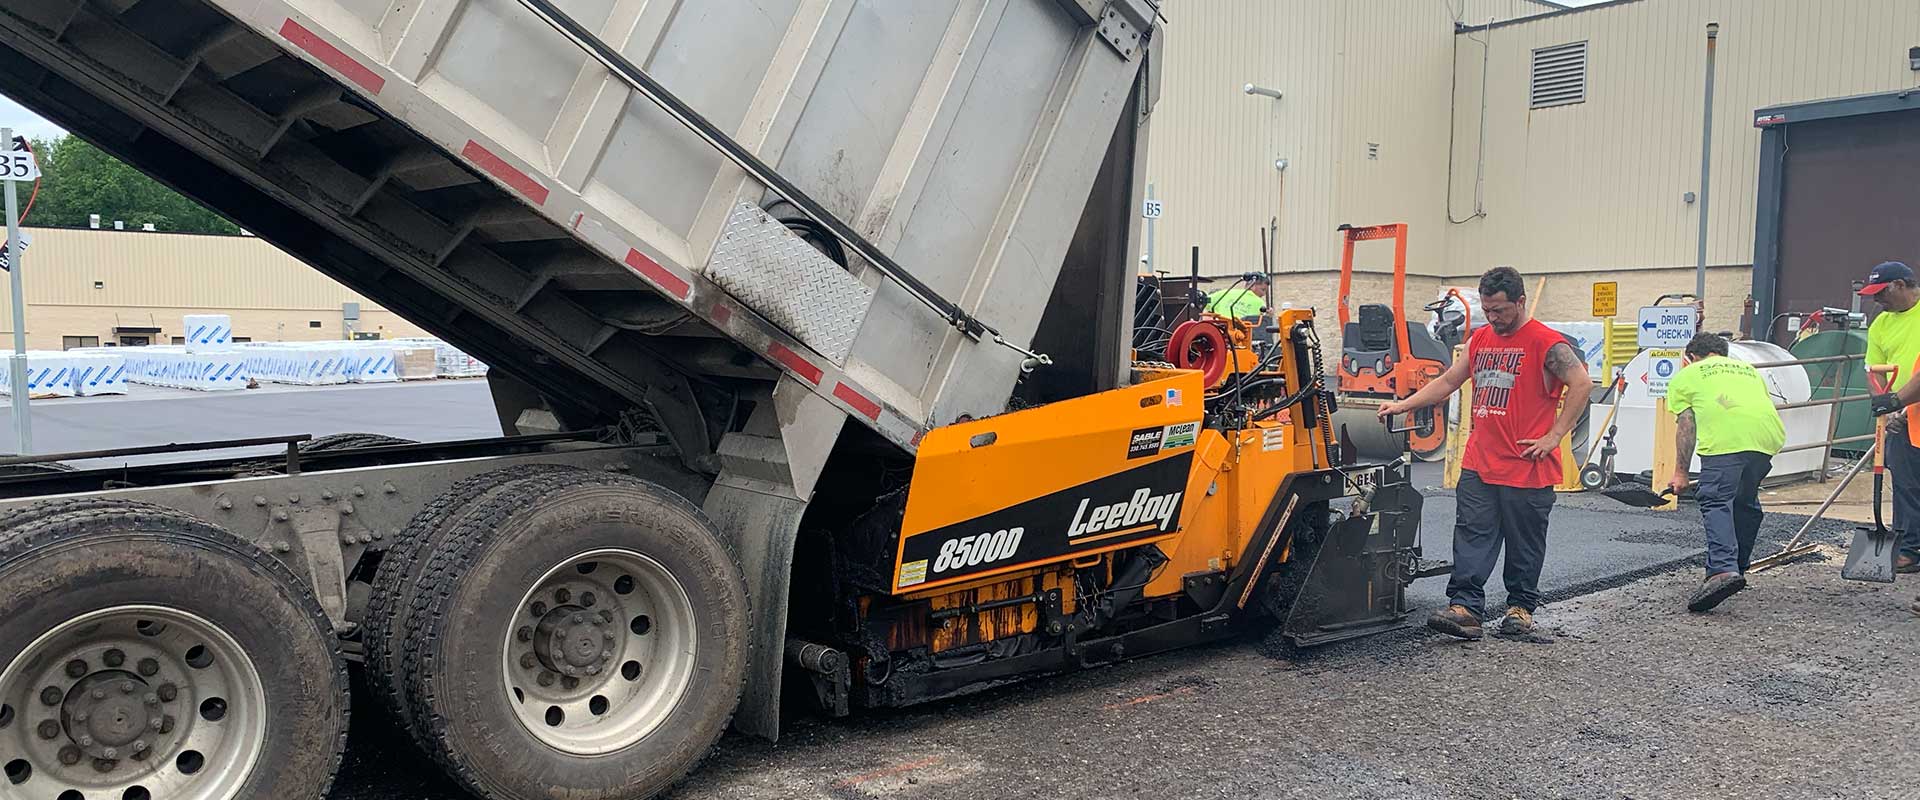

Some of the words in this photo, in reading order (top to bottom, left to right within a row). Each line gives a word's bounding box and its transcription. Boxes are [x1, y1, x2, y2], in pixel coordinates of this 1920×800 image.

[1146, 202, 1161, 216] B5
[1661, 315, 1689, 325] DRIVER
[1656, 329, 1692, 339] CHECK-IN
[1133, 431, 1161, 441] SABLE
[1067, 487, 1184, 537] LeeBoy
[932, 526, 1025, 573] 8500D
